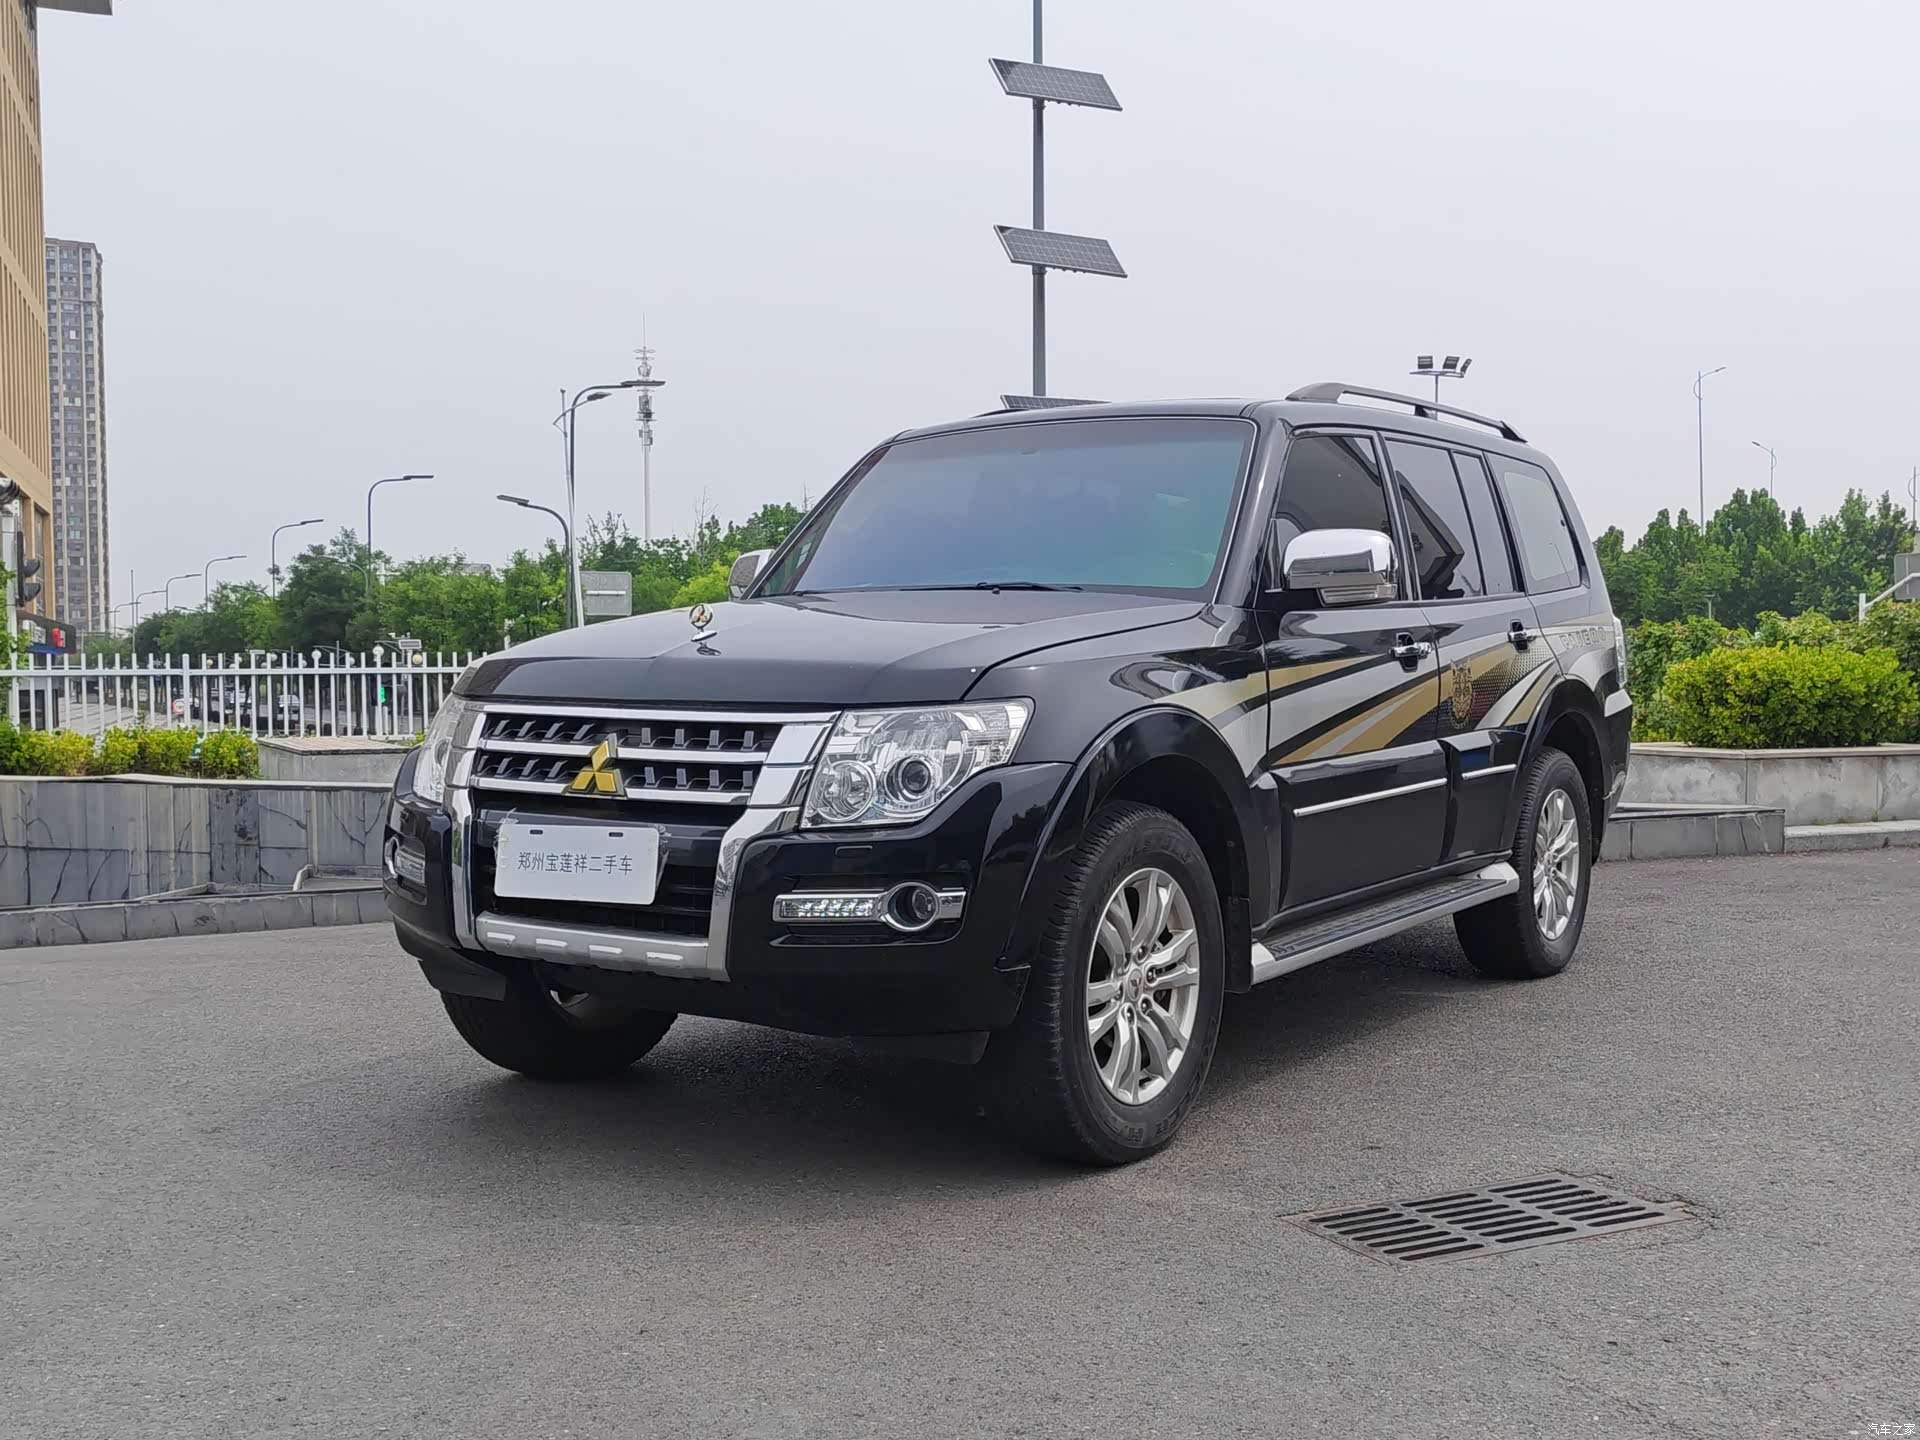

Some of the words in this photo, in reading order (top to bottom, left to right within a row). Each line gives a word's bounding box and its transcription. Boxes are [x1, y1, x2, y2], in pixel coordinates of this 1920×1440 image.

[1559, 626, 1606, 650] PAJERO
[517, 851, 633, 876] 郑州宝莲祥二手车
